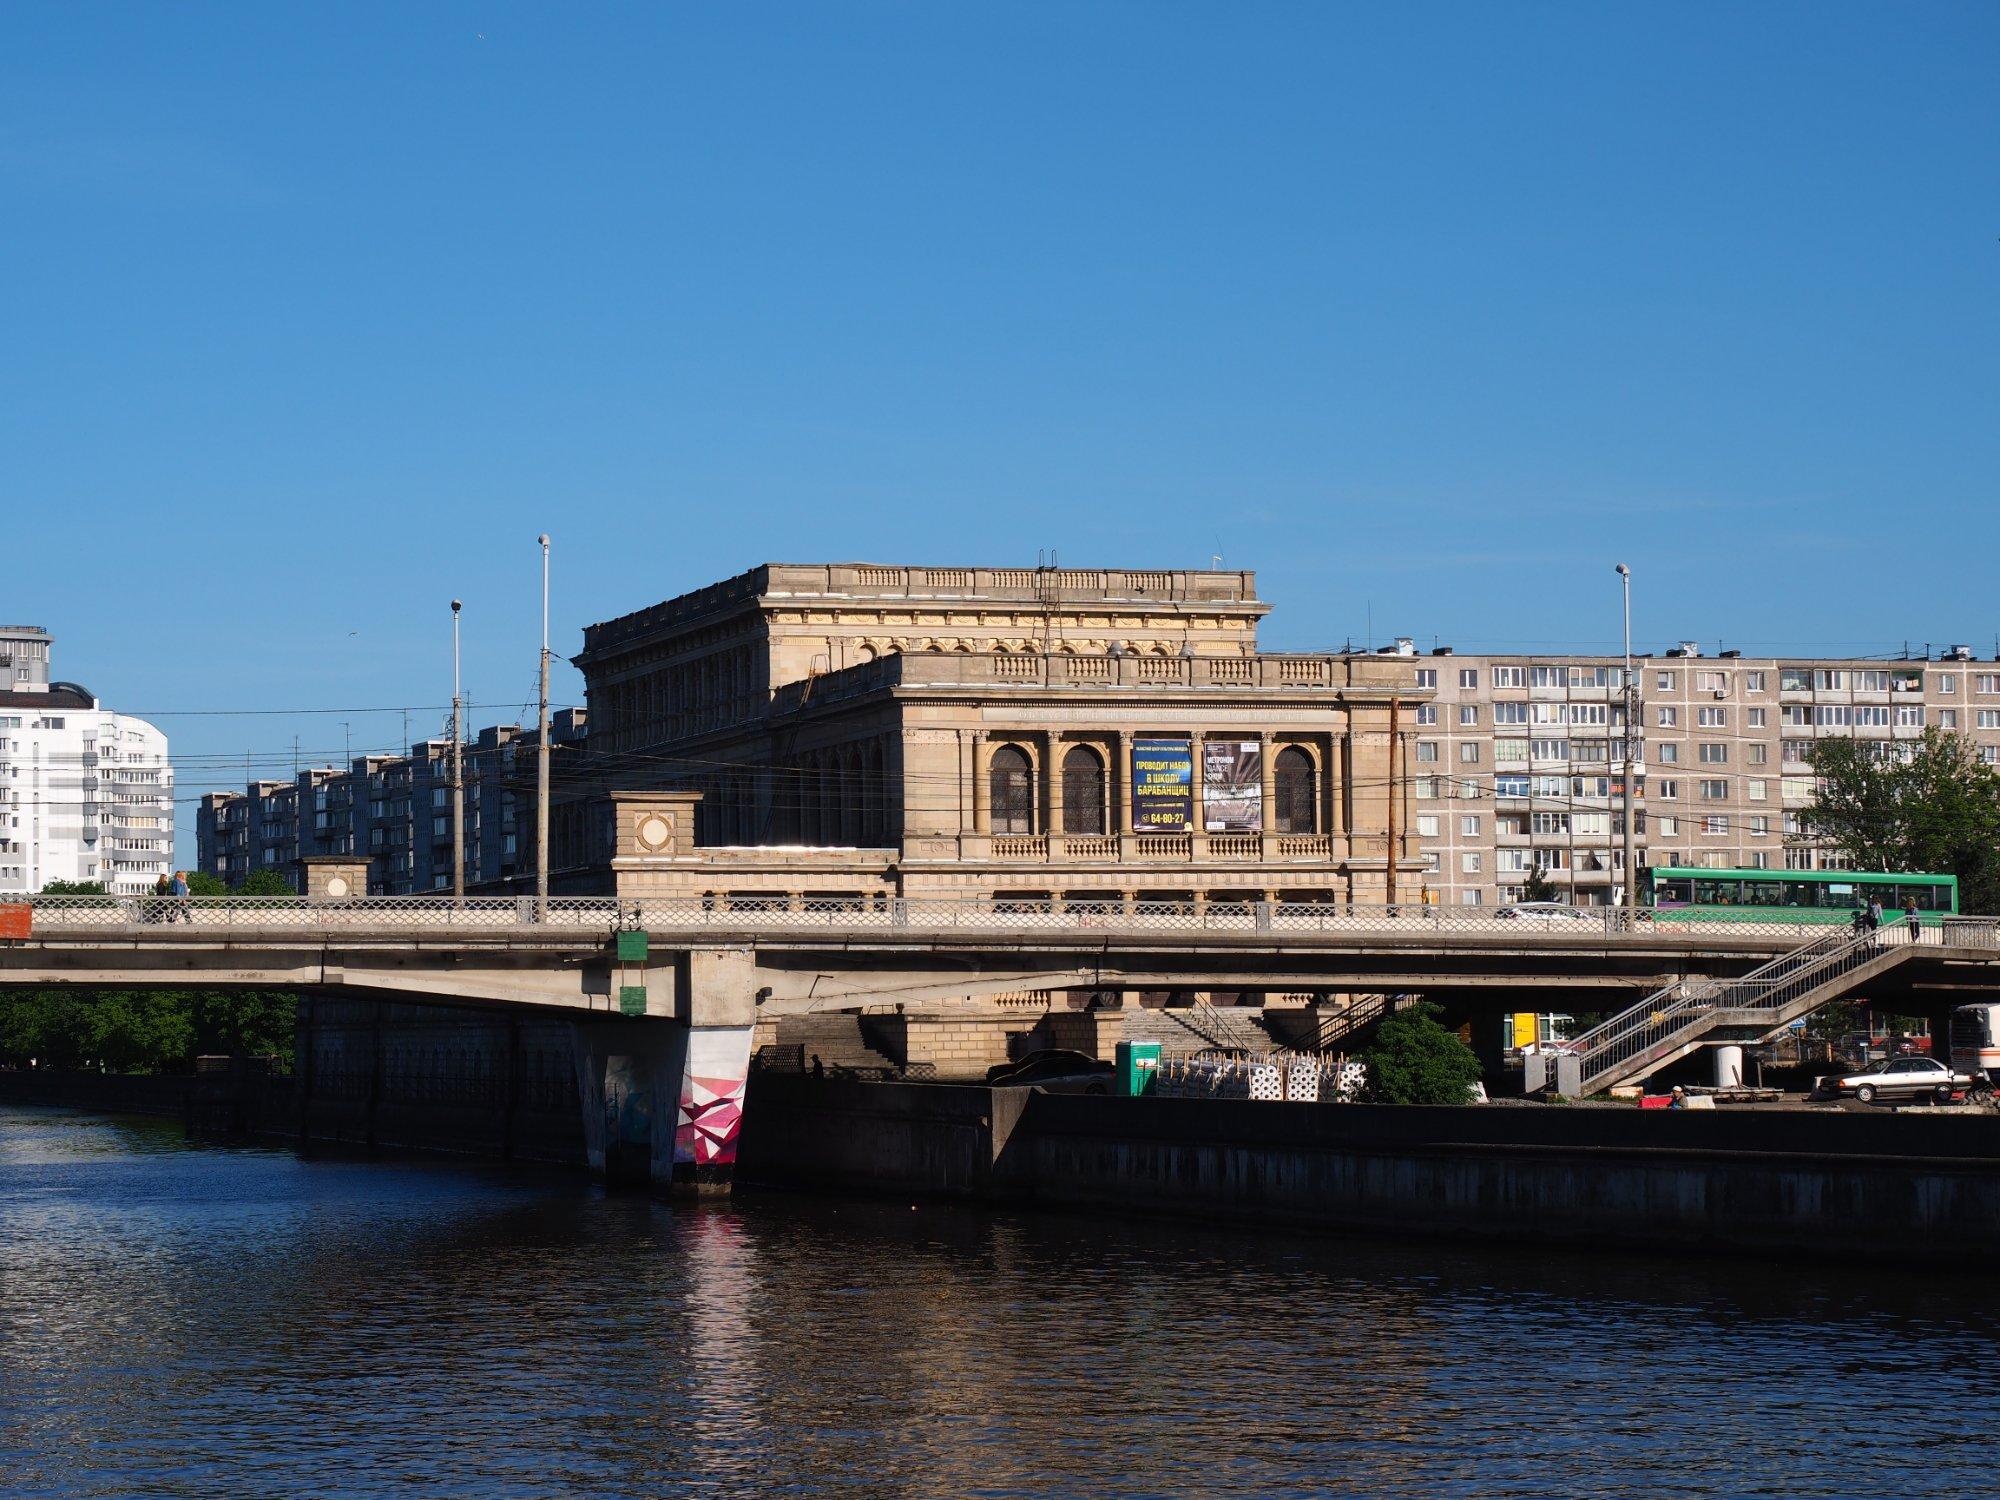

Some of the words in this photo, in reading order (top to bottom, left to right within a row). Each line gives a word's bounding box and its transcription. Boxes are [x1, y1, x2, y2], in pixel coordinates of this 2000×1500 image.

[1207, 756, 1234, 764] МЕТРОНОМ
[1136, 761, 1168, 770] ПРОВОДИТ
[1170, 761, 1190, 770] НАБОР
[1146, 773, 1152, 783] В
[1153, 773, 1180, 783] ШКОЛУ
[1137, 785, 1189, 796] БАРАБАНЩИЦ
[1151, 813, 1184, 824] 64-80-27
